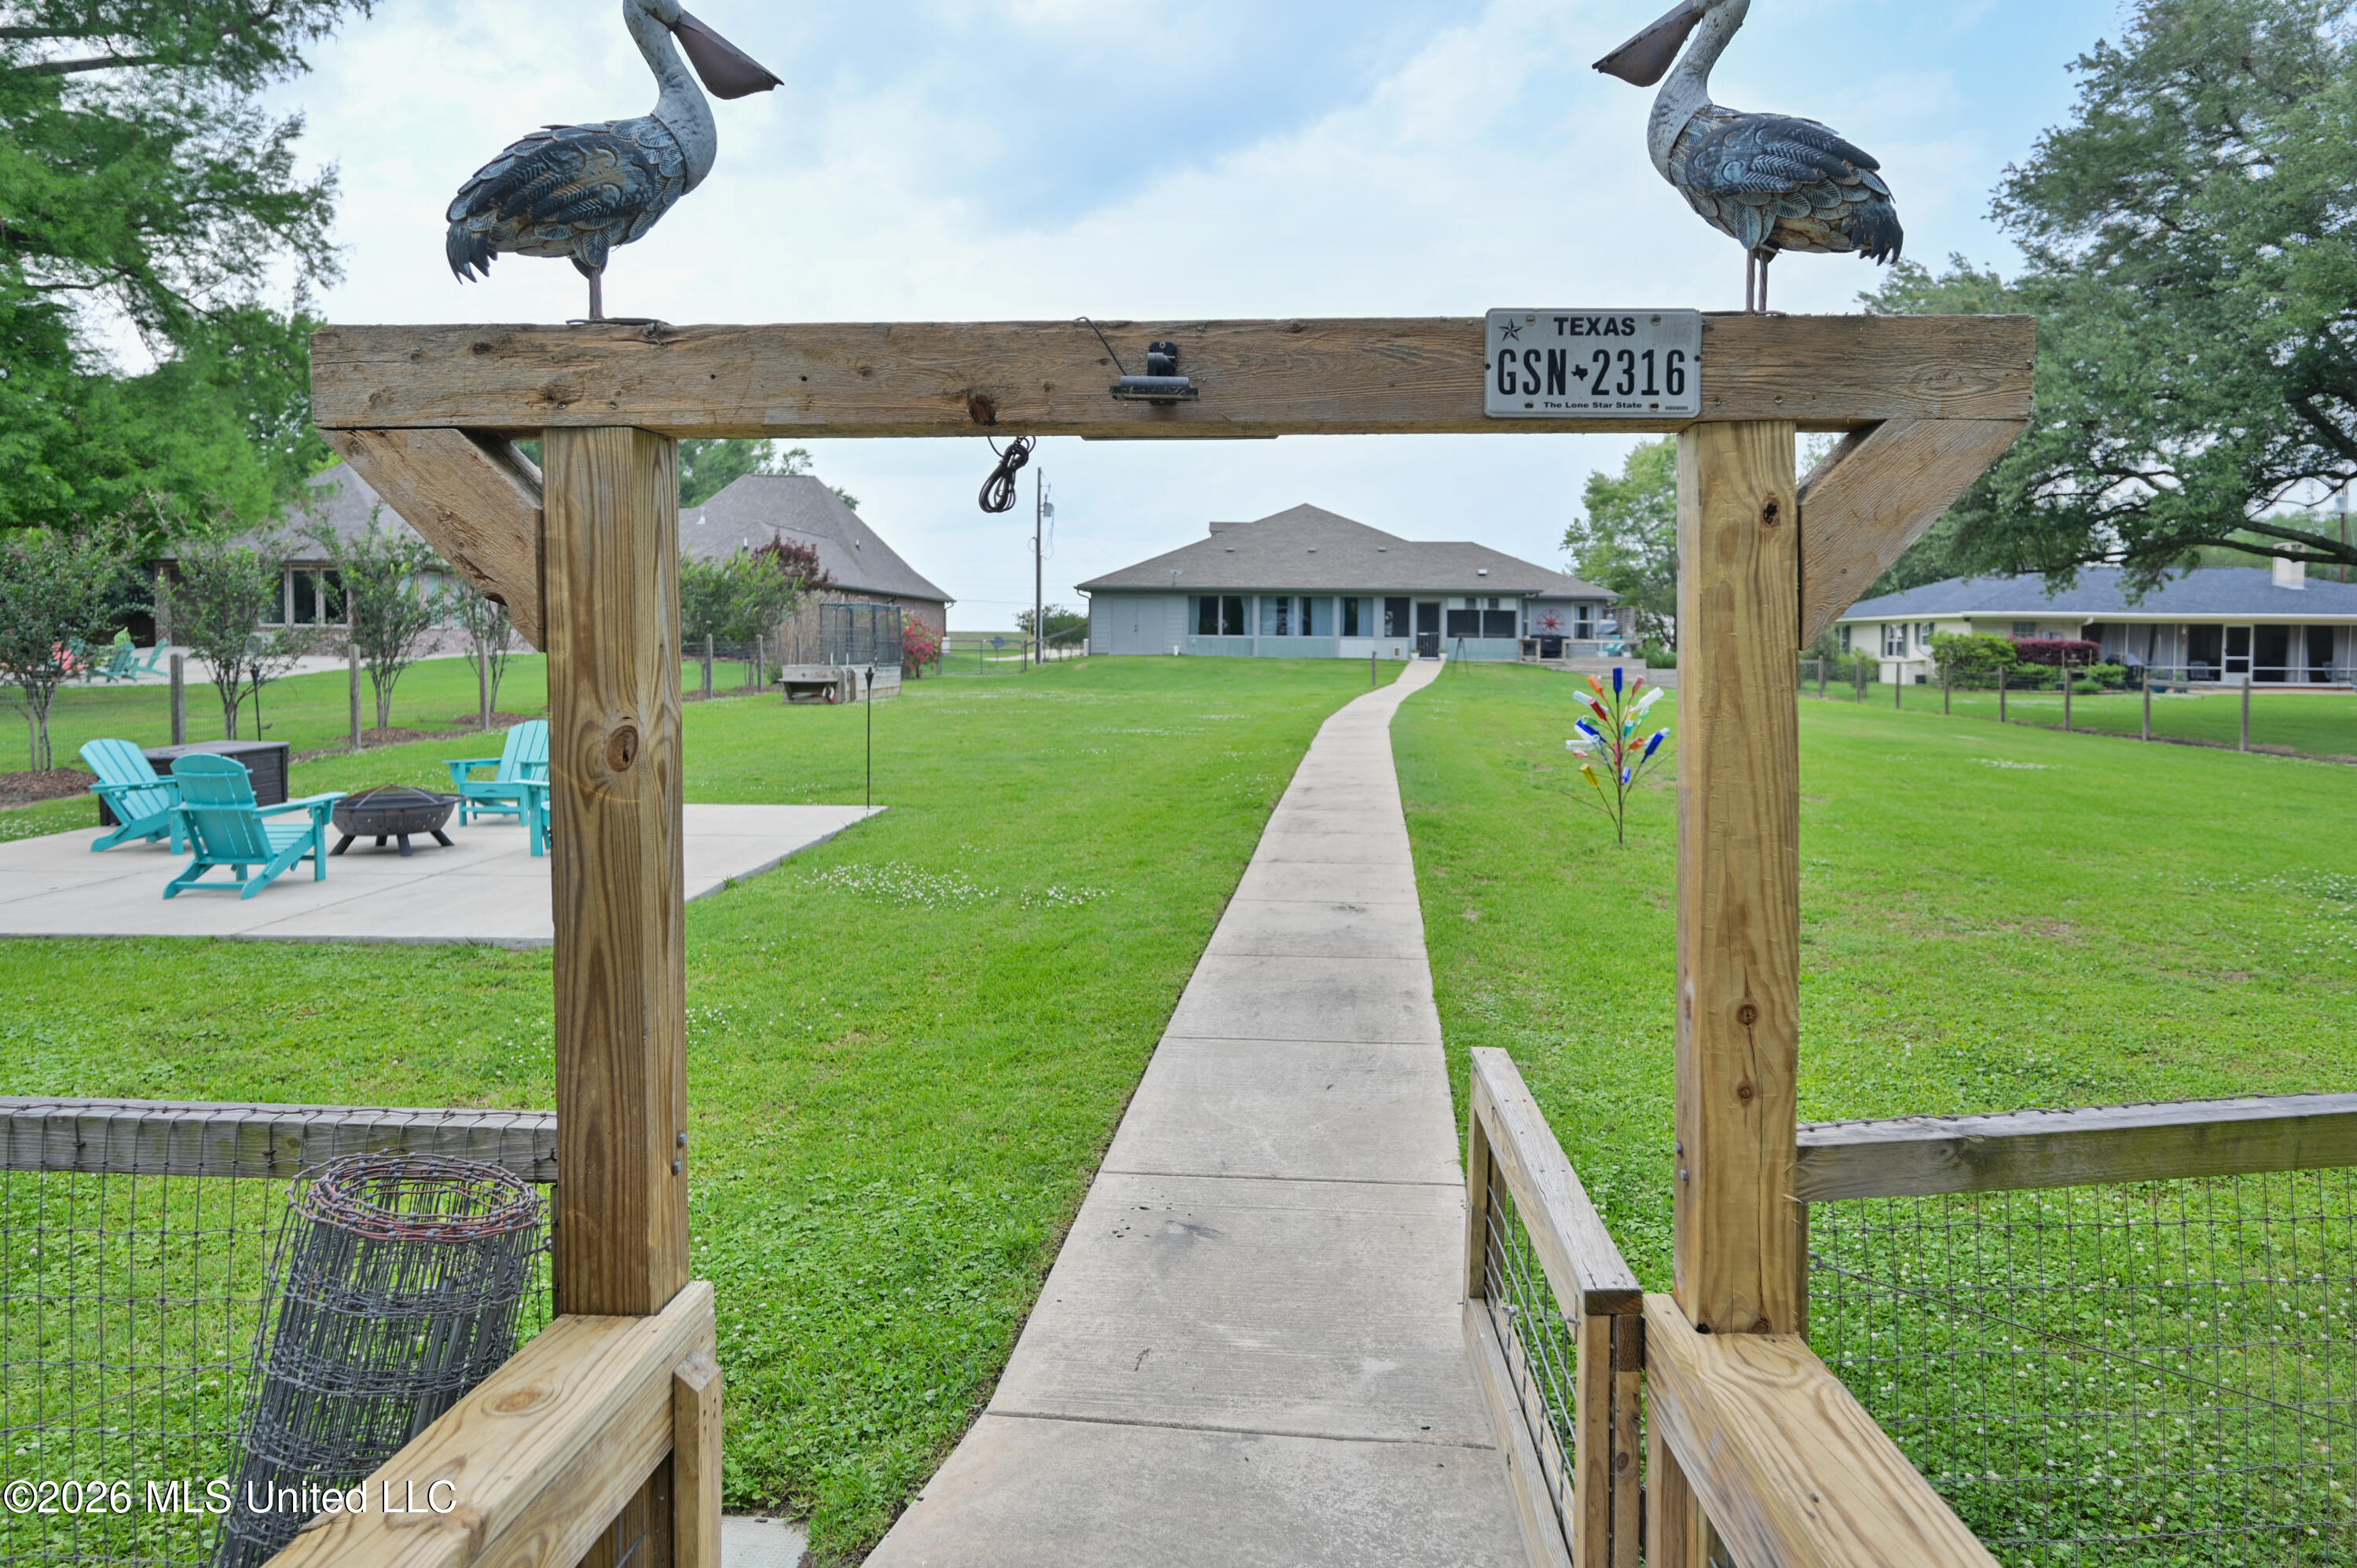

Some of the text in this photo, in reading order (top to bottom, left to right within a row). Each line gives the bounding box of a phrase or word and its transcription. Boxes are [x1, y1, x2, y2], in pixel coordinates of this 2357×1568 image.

[1553, 317, 1636, 336] TEXAS
[1497, 348, 1685, 396] GSN 2316
